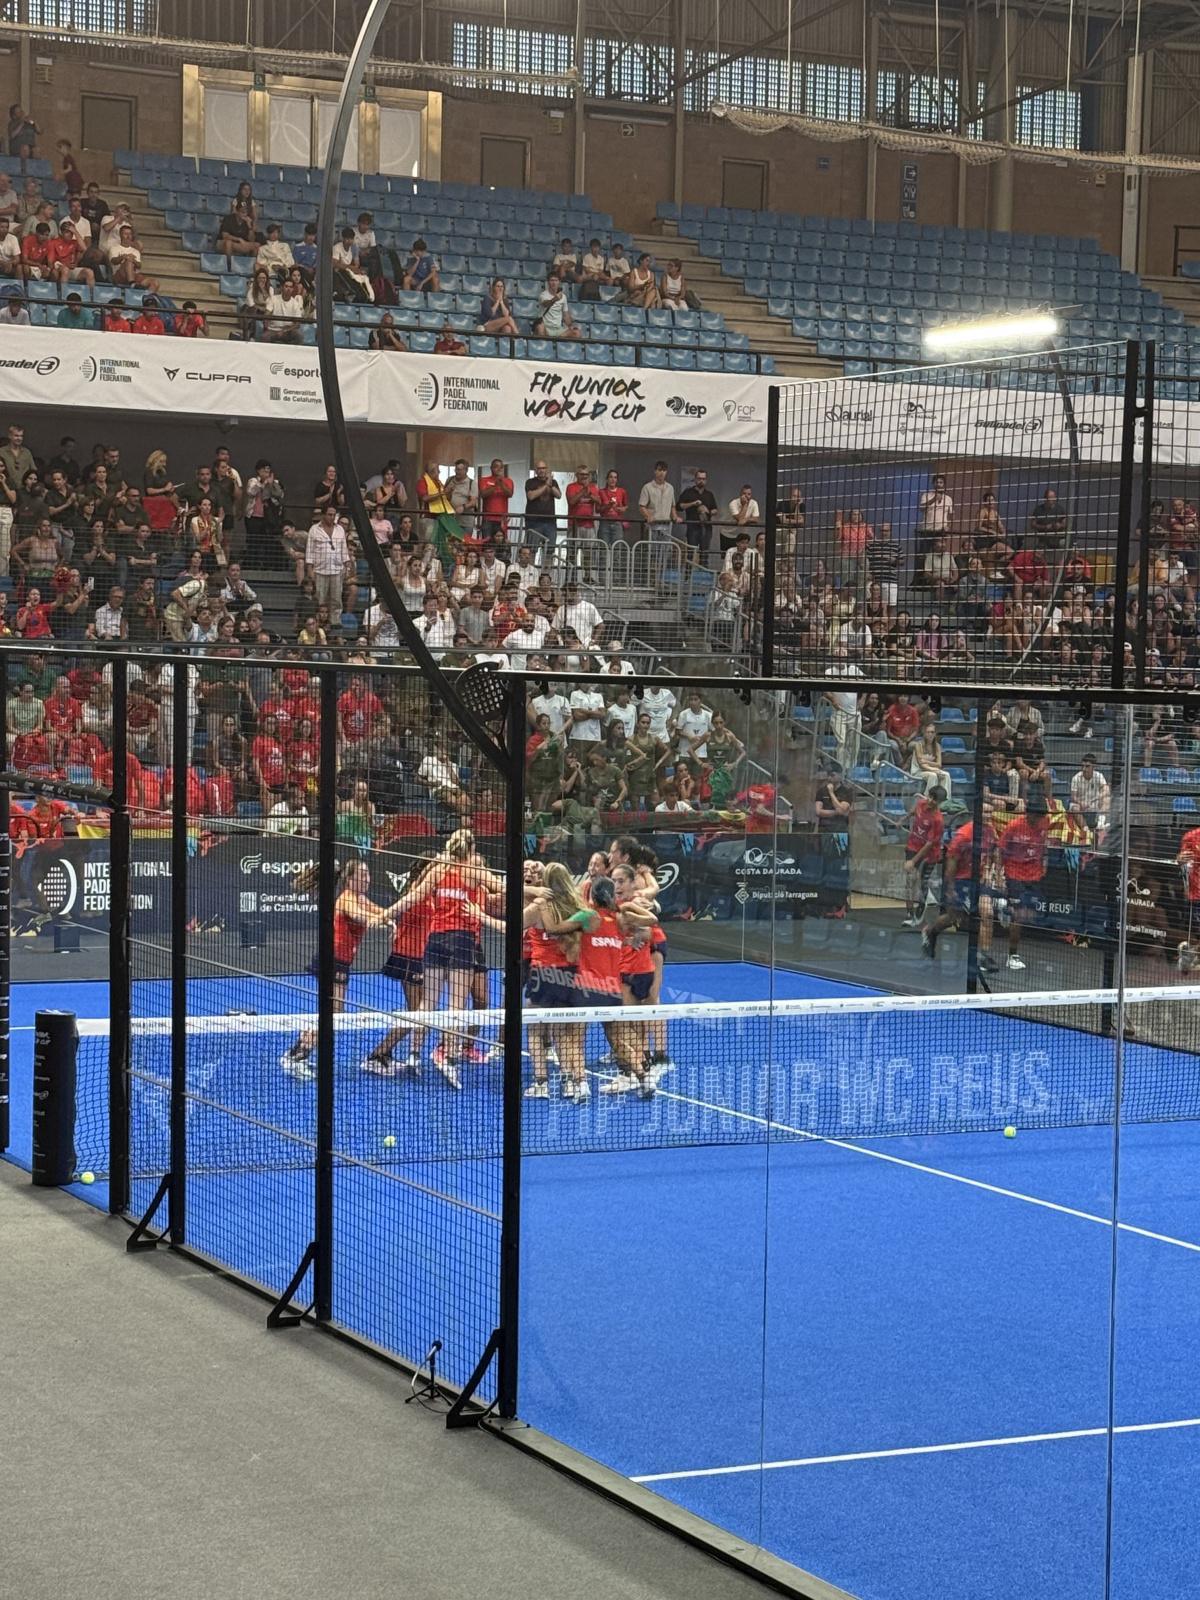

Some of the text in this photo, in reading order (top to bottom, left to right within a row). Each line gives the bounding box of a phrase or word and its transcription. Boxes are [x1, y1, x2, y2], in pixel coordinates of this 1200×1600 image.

[99, 358, 140, 369] INTERNATIONAL
[99, 366, 117, 375] PADEL
[284, 366, 321, 379] esport
[99, 375, 132, 383] FEDERATION
[185, 372, 252, 384] CUPRA
[443, 376, 500, 391] INTERNATIONAL
[529, 371, 646, 400] FIP JUNIOR
[443, 387, 467, 400] PADEL
[443, 399, 488, 412] FEDERATION
[523, 398, 646, 422] WORLD CUP
[685, 402, 707, 419] fep
[737, 405, 756, 415] FCP
[83, 861, 173, 878] INTETIONAL
[735, 867, 761, 876] COSTA
[83, 878, 111, 895] PADE
[83, 894, 153, 911] FEDETION
[260, 903, 272, 913] de
[1049, 902, 1071, 915] REUS
[641, 1061, 821, 1134] JUNIOR
[838, 1057, 914, 1127] WC
[929, 1050, 1050, 1121] REUS
